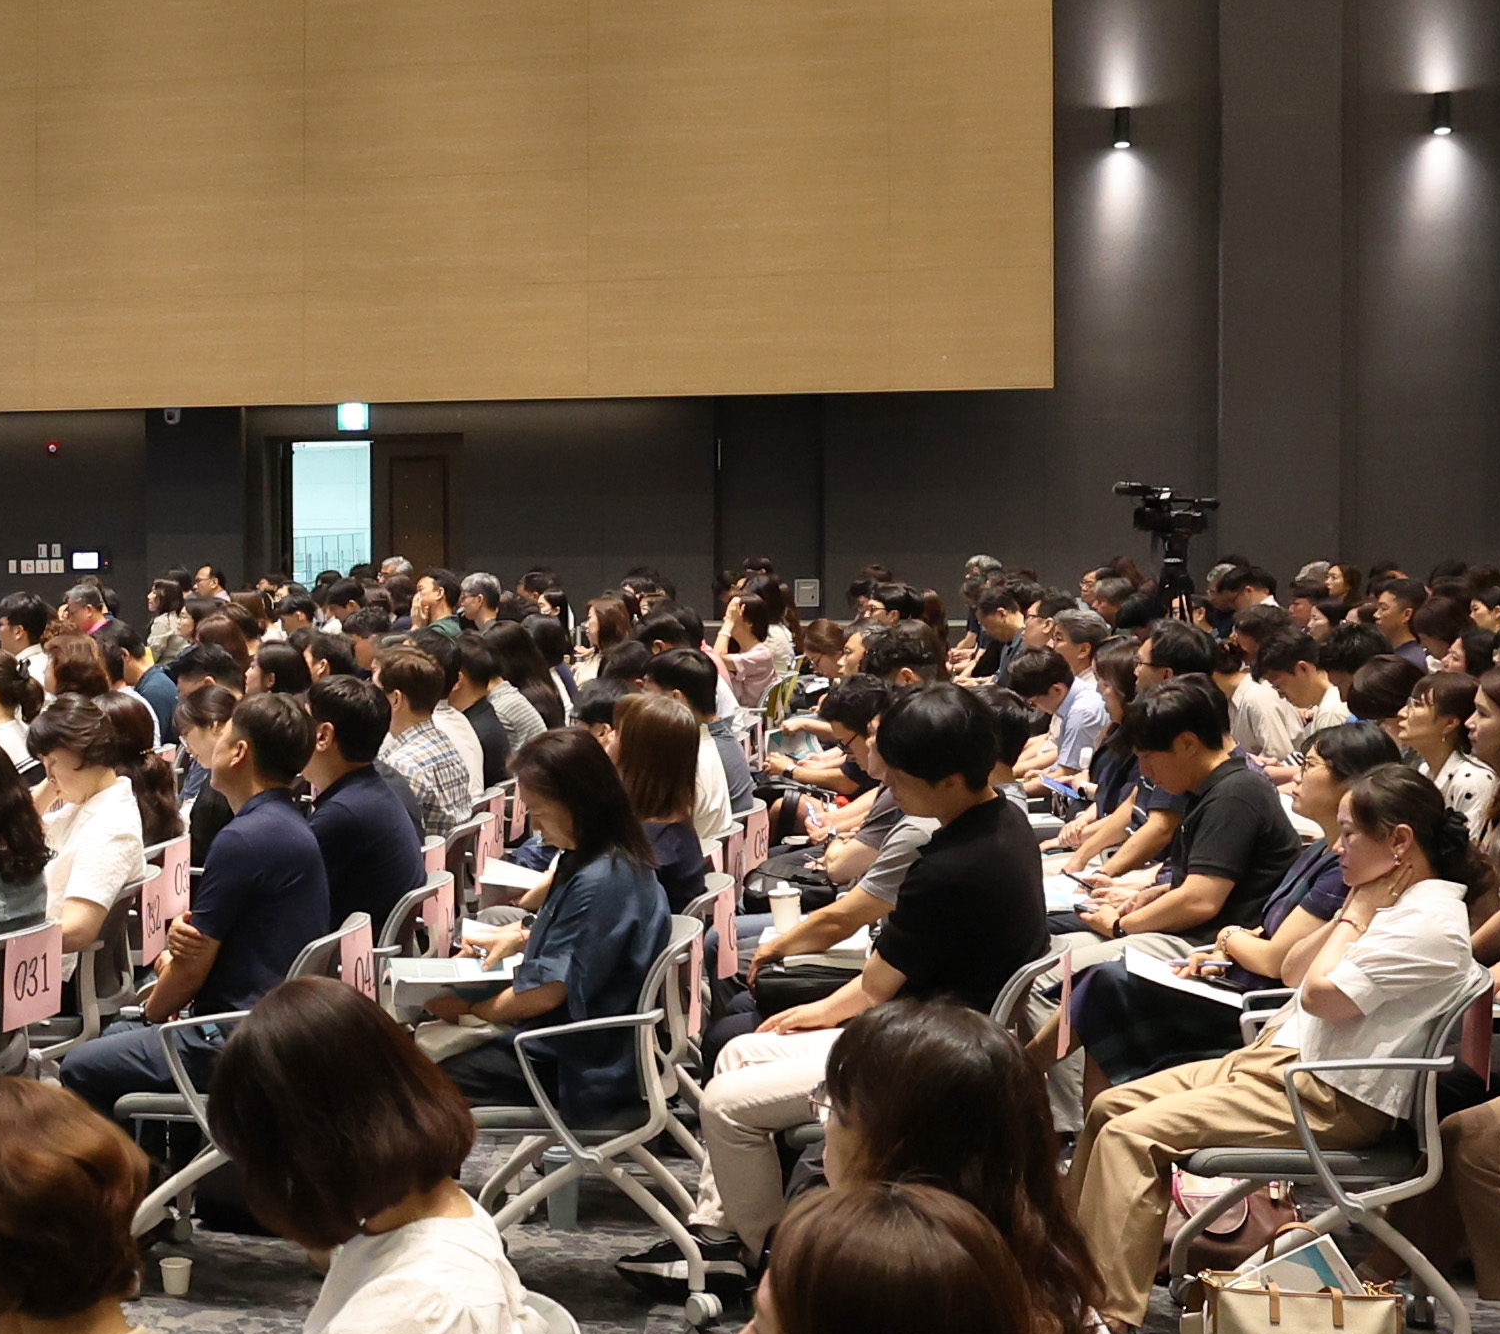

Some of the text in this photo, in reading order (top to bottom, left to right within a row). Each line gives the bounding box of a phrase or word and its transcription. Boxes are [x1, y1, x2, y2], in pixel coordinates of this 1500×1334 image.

[174, 858, 190, 896] 03
[12, 952, 52, 1002] 031
[354, 951, 376, 993] 04
